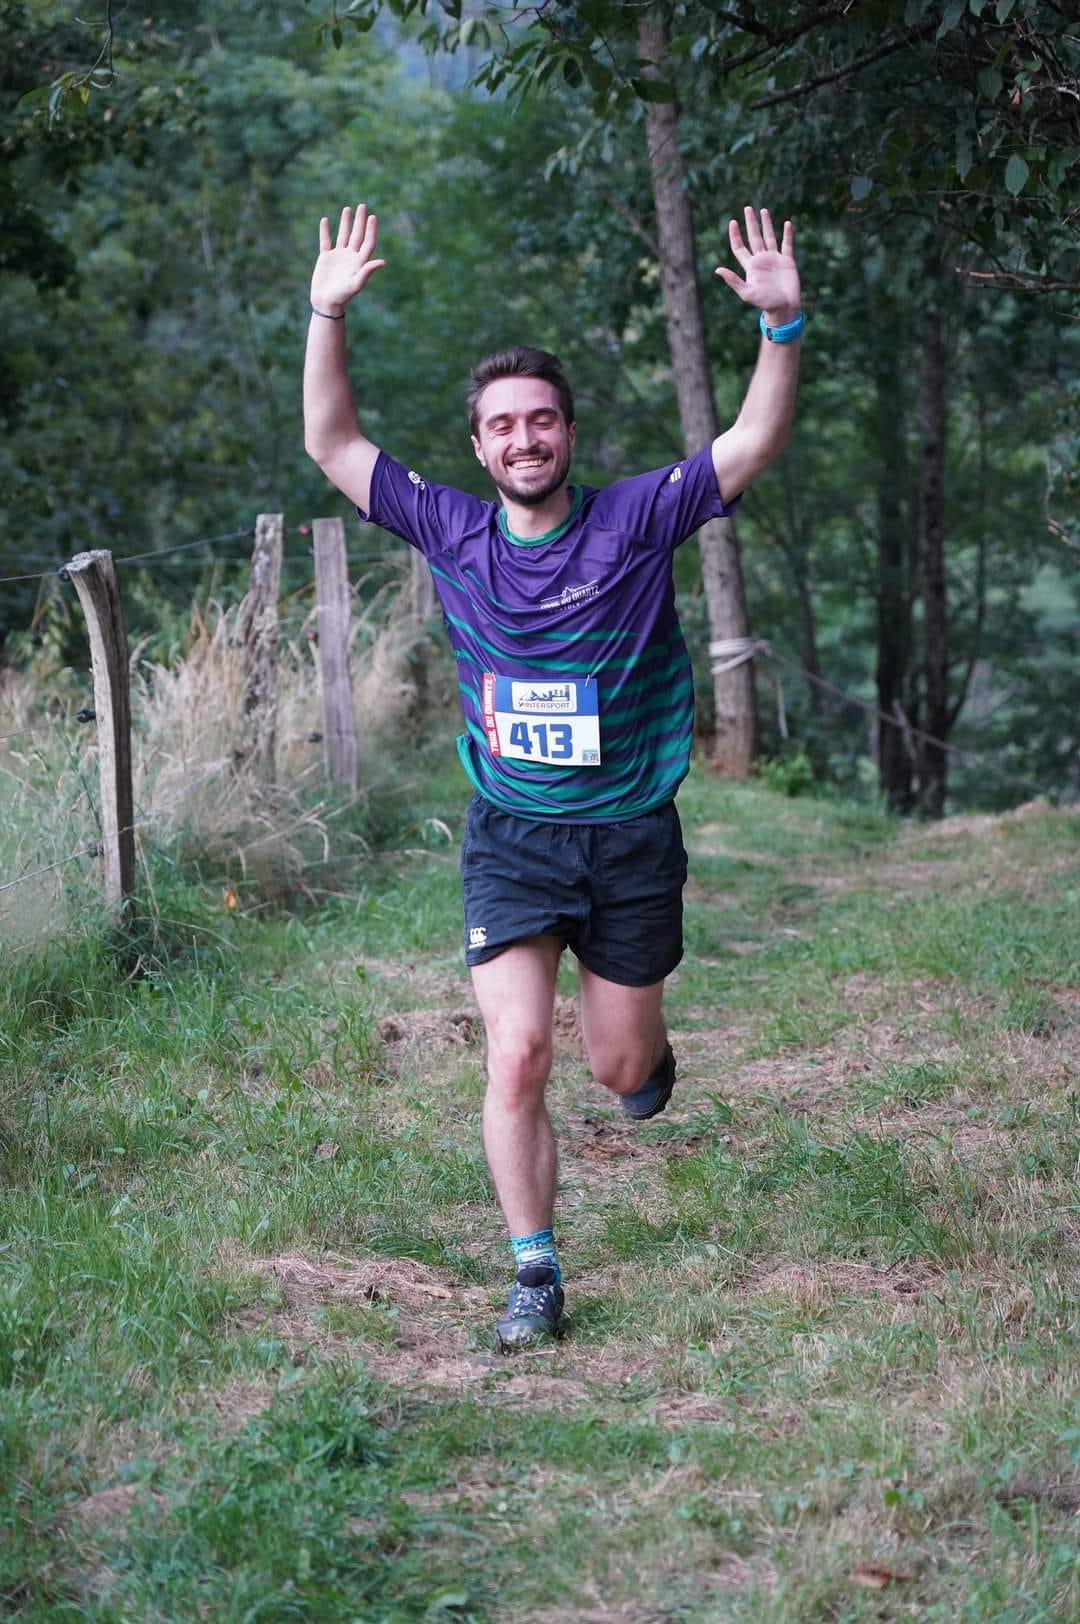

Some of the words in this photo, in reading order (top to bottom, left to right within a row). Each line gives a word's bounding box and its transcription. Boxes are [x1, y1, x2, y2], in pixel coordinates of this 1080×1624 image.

[561, 596, 571, 604] DU
[572, 585, 600, 600] QUARTZ
[484, 678, 494, 715] QUARTZ
[485, 715, 495, 728] DU
[487, 728, 500, 753] TRAIL
[510, 722, 573, 759] 413
